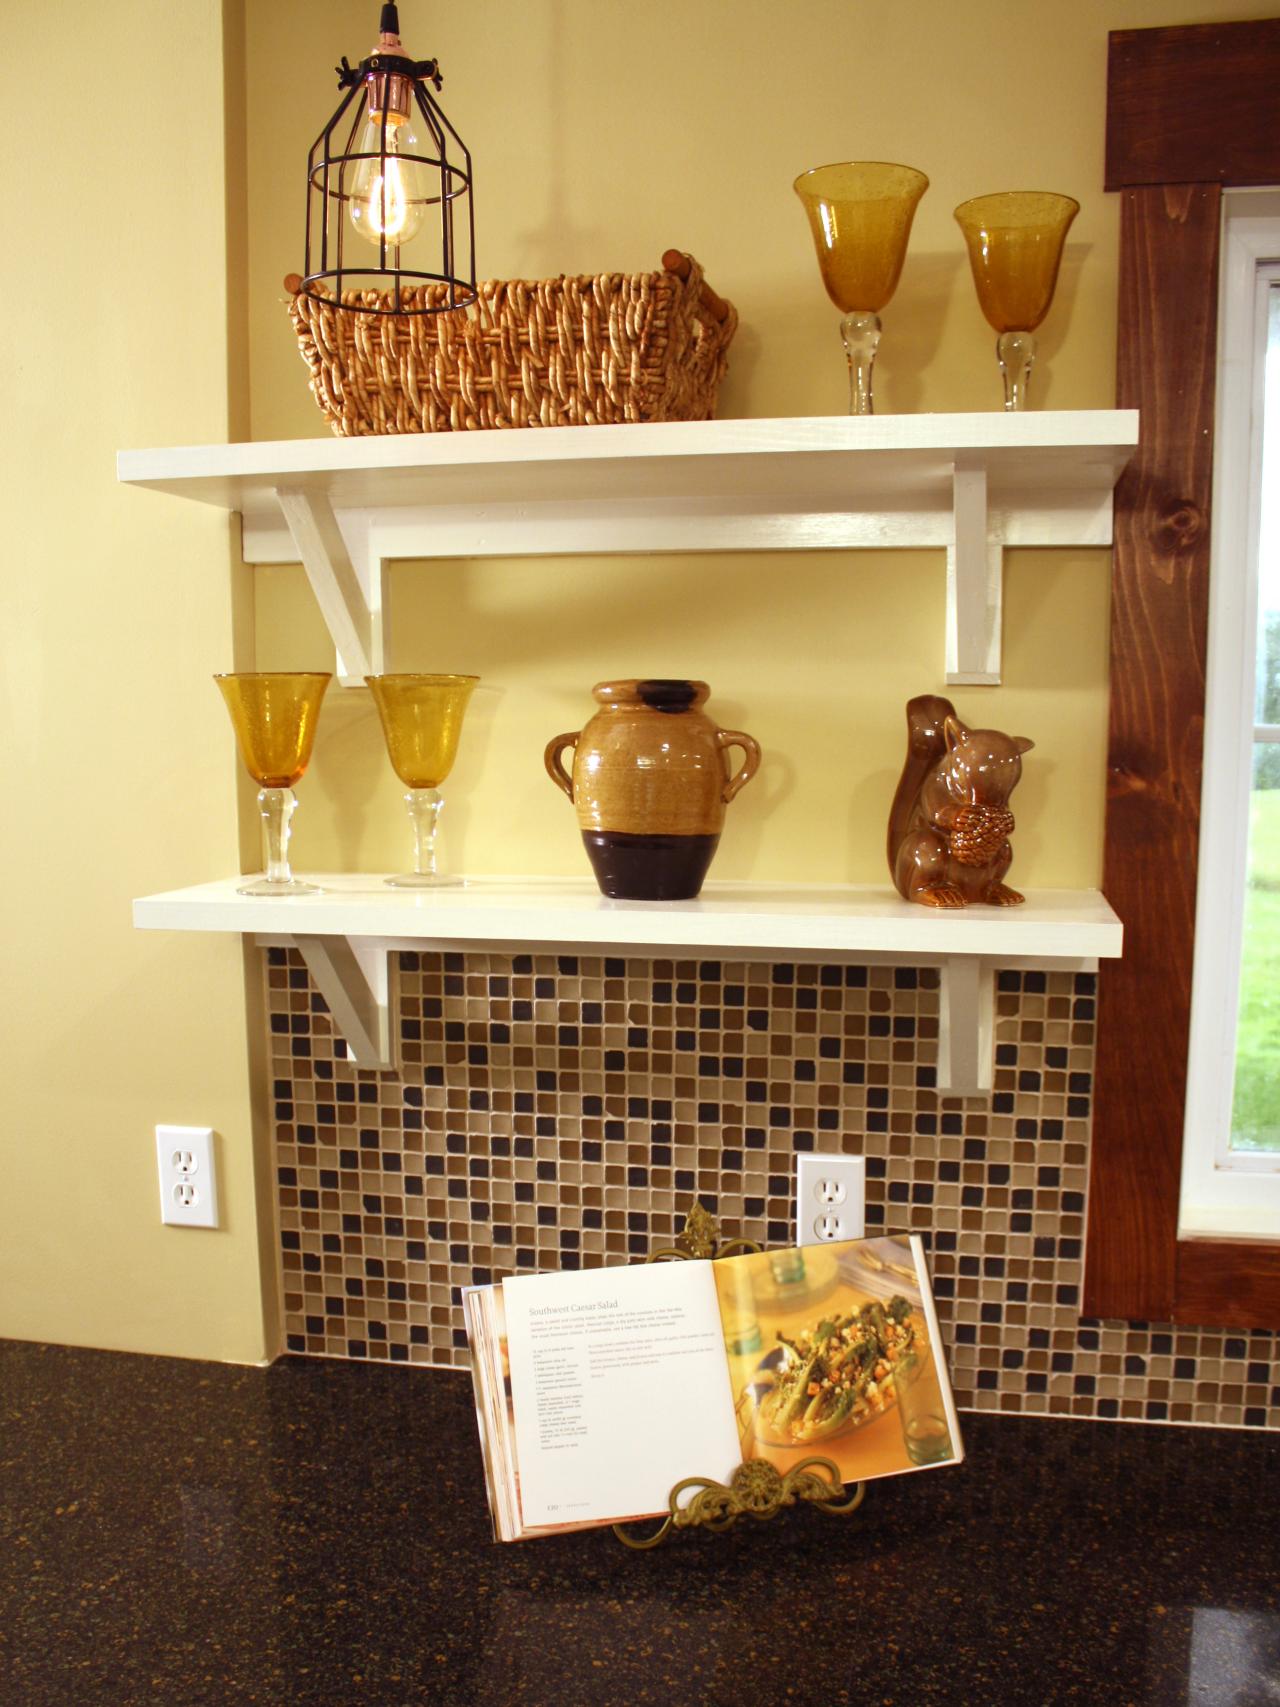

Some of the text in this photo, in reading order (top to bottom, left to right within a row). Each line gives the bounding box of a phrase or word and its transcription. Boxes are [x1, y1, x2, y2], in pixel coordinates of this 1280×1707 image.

[529, 1300, 618, 1317] Southwest Caesar Salad
